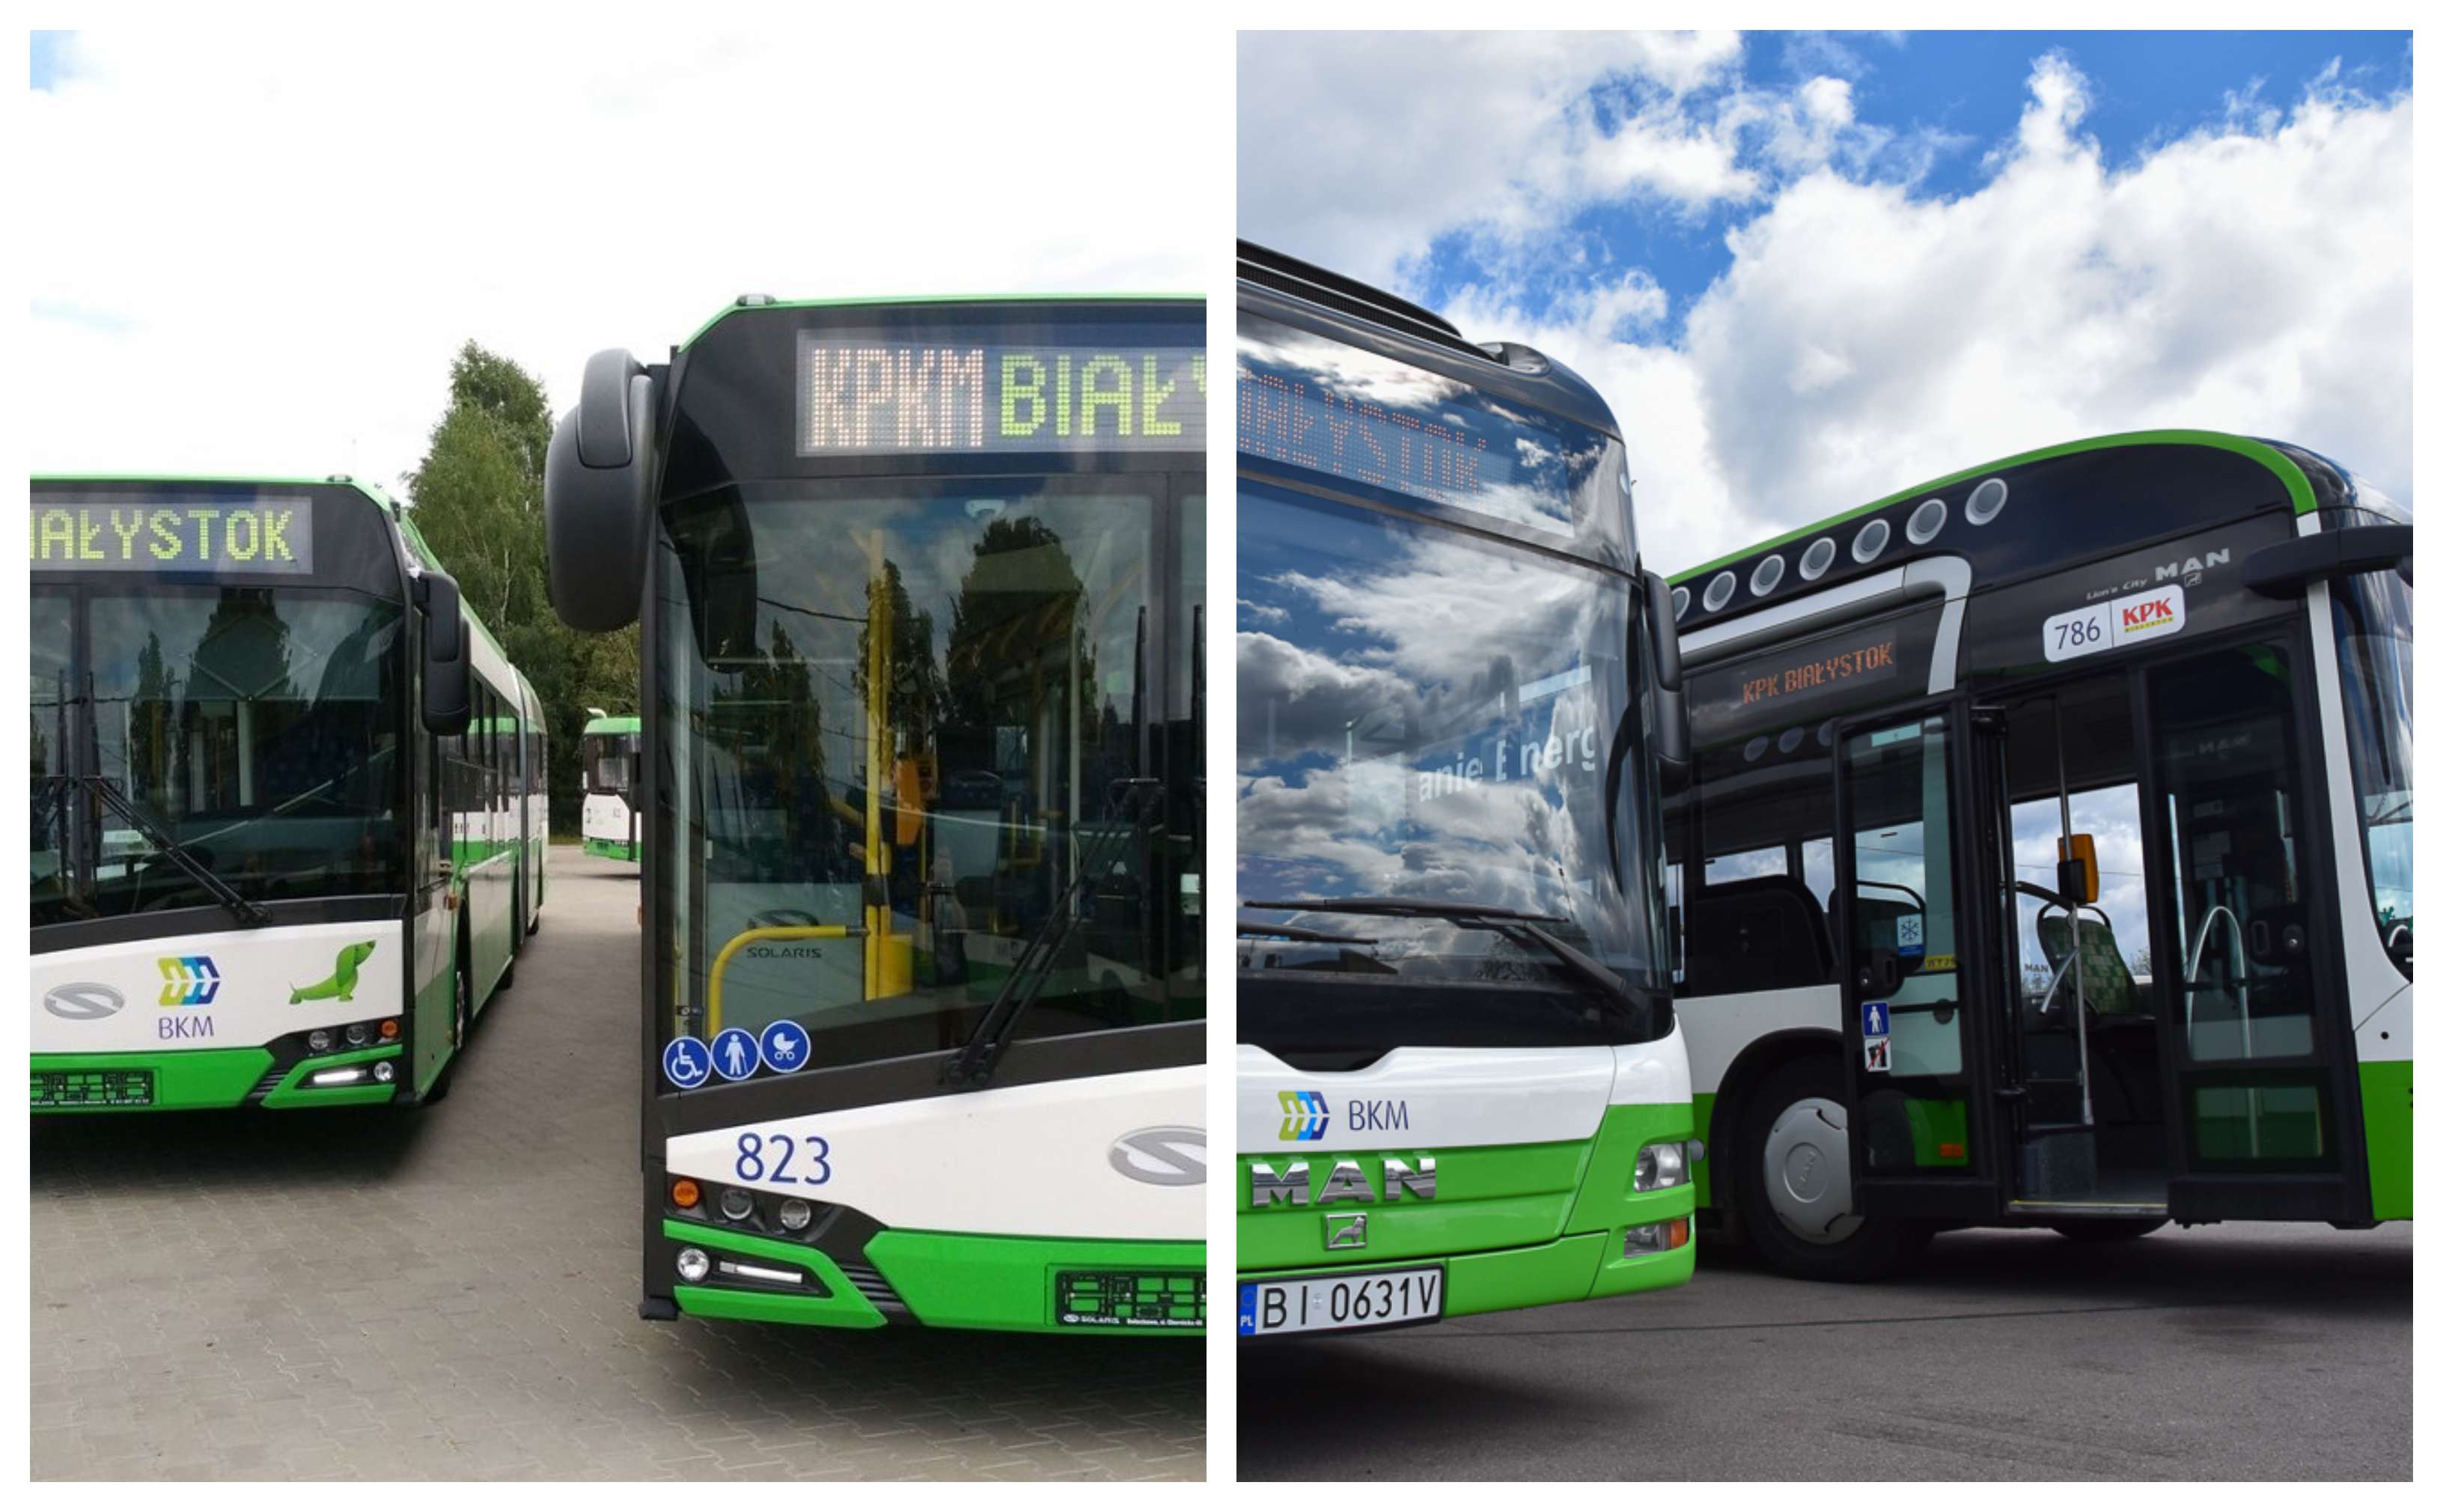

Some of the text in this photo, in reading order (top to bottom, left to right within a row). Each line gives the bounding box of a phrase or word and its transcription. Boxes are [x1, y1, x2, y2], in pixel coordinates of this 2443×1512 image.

[811, 348, 1207, 447] KPKM BIAŁ
[2122, 578, 2147, 590] City
[2154, 548, 2230, 582] MAN
[2122, 597, 2174, 627] KPK
[2055, 616, 2101, 650] 786
[1742, 641, 1893, 704] KPK BIAŁYSTOK
[746, 947, 823, 959] SOLARIS
[157, 1015, 215, 1040] BKM
[1348, 1100, 1409, 1131] BKM
[736, 1132, 832, 1185] 823
[1251, 1158, 1436, 1207] MAN
[1262, 1273, 1437, 1329] BI 0631V
[1239, 1314, 1254, 1327] PL
